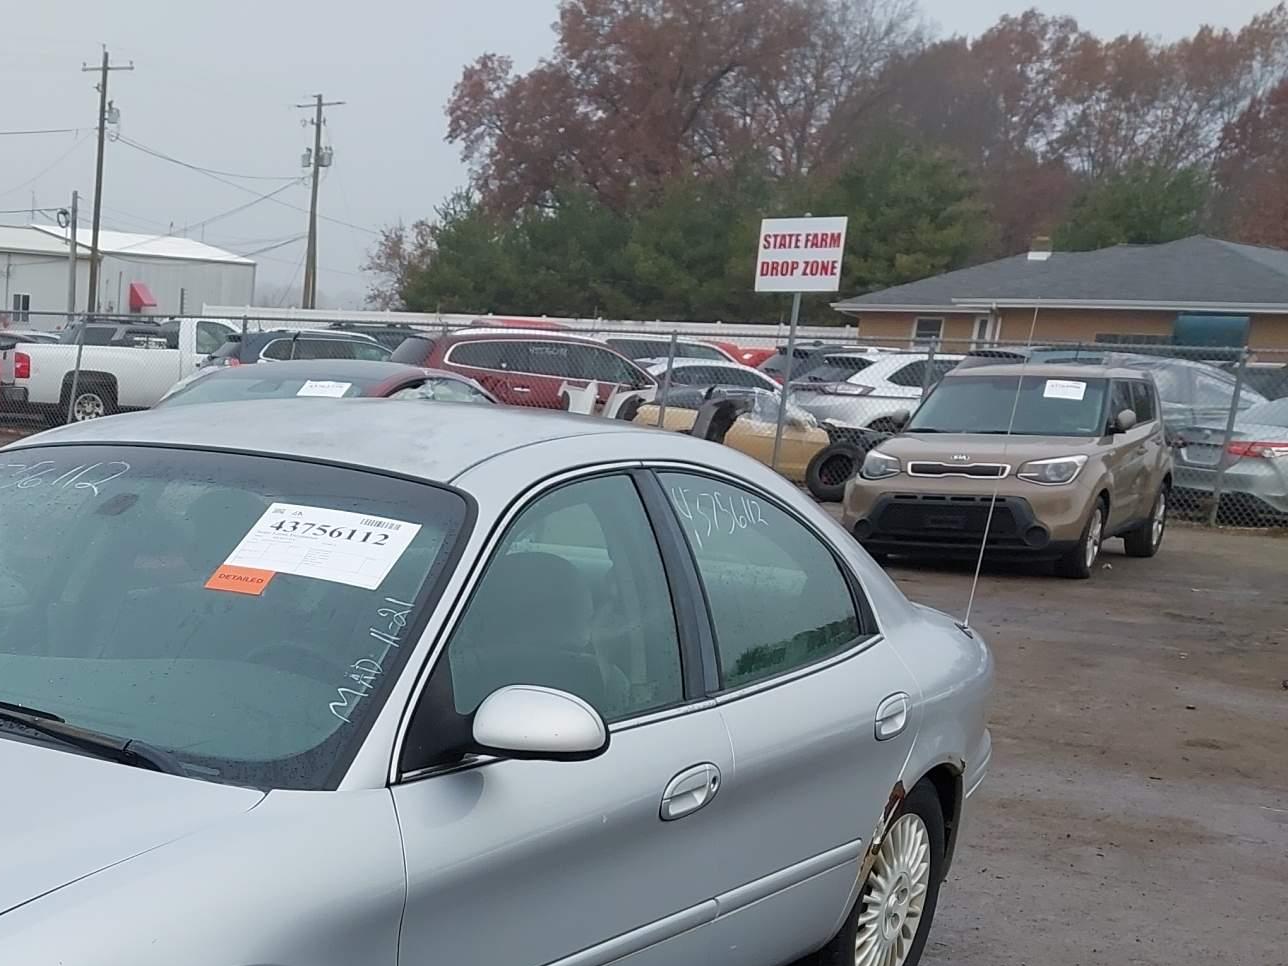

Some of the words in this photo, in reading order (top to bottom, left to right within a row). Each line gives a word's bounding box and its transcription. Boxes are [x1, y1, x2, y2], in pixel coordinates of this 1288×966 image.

[763, 233, 802, 250] STATE
[804, 232, 841, 249] FARM
[760, 261, 799, 277] DROP
[802, 261, 838, 276] ZONE
[269, 519, 390, 546] 43756112
[218, 573, 265, 584] DETAILED
